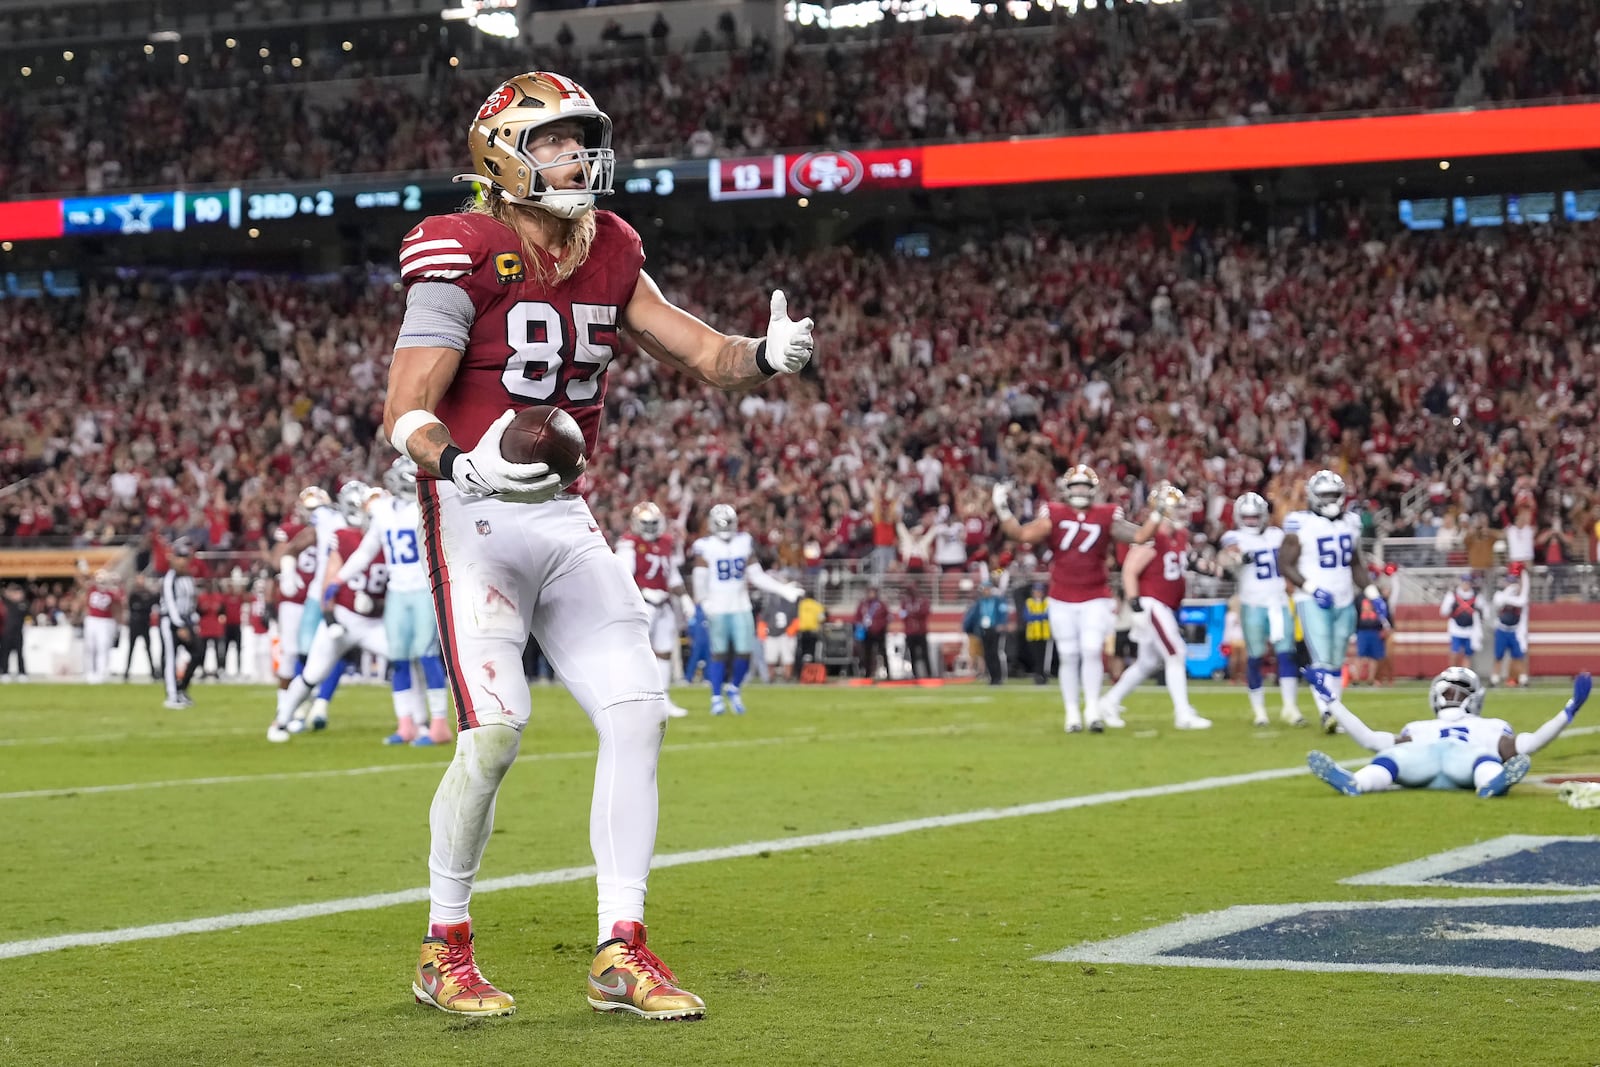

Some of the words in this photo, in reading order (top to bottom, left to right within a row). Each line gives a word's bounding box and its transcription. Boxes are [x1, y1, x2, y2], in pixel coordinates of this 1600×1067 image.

[732, 164, 761, 191] 13
[898, 158, 912, 178] 3
[655, 169, 674, 196] 3
[193, 196, 222, 222] 10
[248, 193, 298, 220] 3RD
[315, 190, 334, 216] 2
[403, 185, 422, 211] 2
[93, 208, 105, 224] 3
[496, 253, 523, 277] C
[501, 301, 618, 402] 85
[386, 529, 420, 565] 13
[1059, 519, 1101, 553] 77
[1317, 534, 1352, 569] 58
